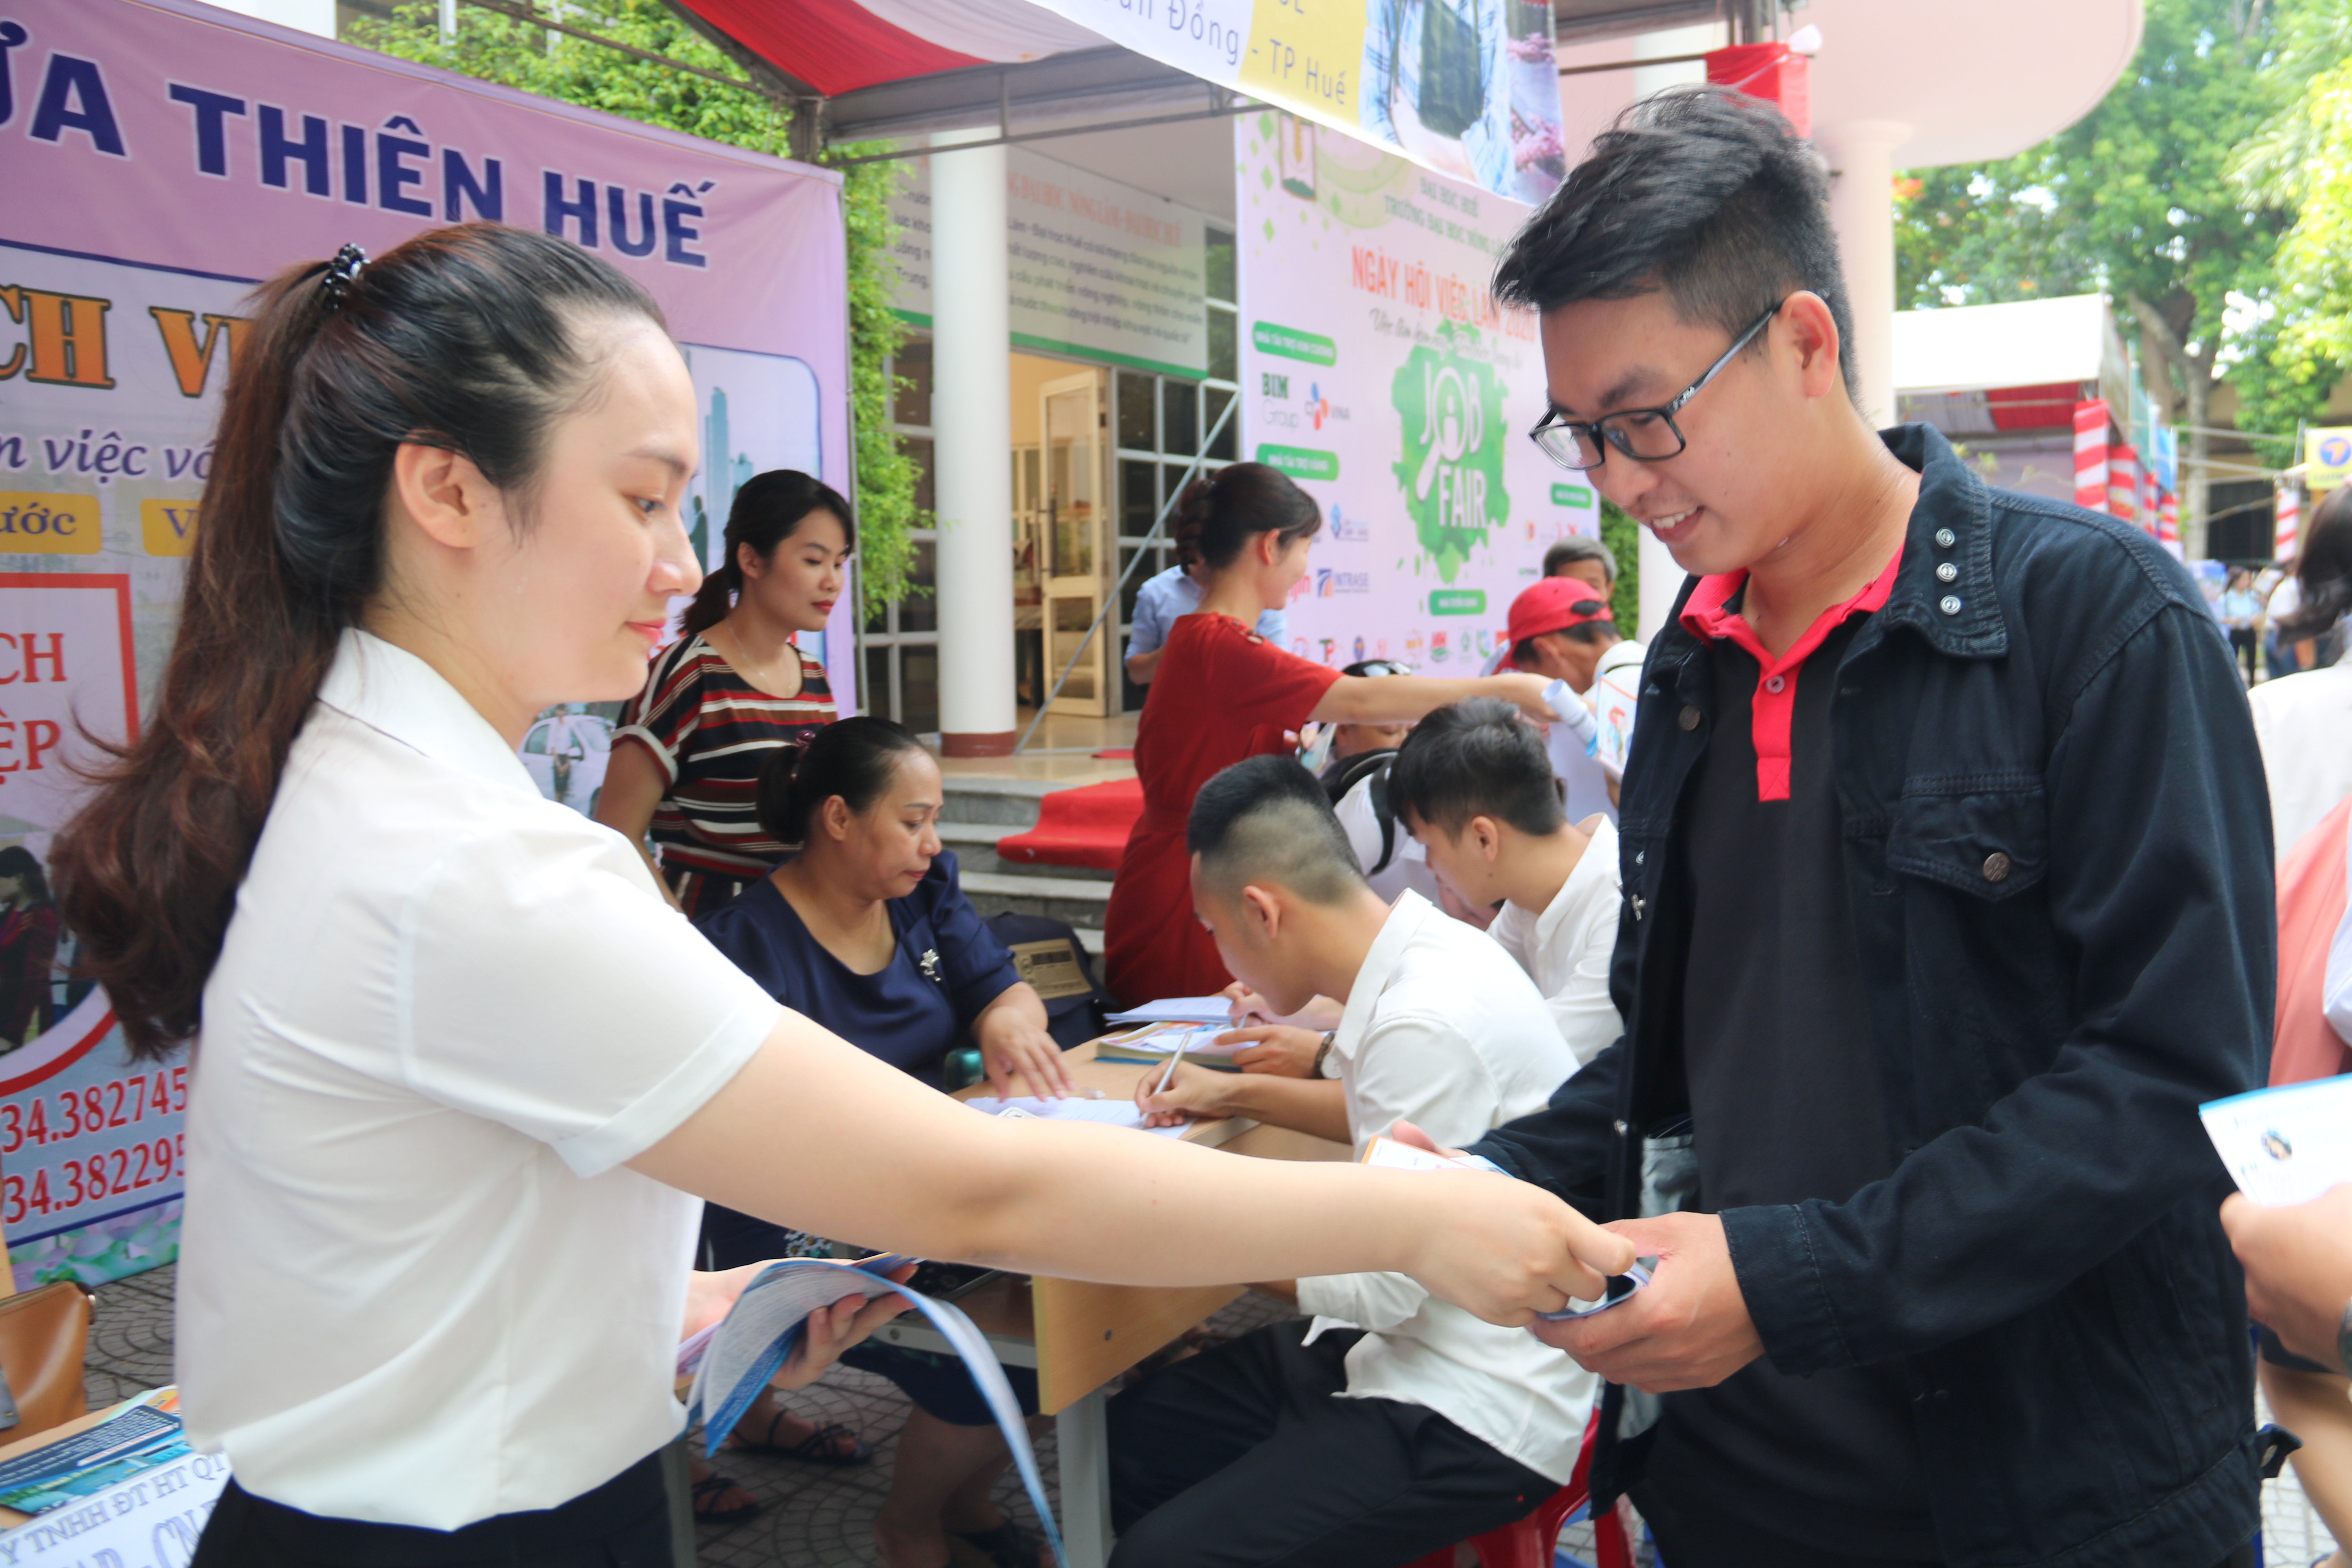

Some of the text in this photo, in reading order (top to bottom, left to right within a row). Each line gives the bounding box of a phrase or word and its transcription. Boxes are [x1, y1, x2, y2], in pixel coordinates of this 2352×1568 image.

[1270, 38, 1295, 80] TP
[1306, 55, 1346, 105] Huế
[168, 82, 503, 223] THIÊN
[544, 171, 716, 267] HUẾ
[1352, 245, 1399, 300] NGÀY
[1405, 260, 1432, 318] HỘI
[1261, 372, 1289, 400] BIM
[1418, 360, 1485, 463] JOB
[44, 429, 148, 484] việc
[1439, 464, 1487, 529] FAIR
[25, 1500, 112, 1553] TNHH
